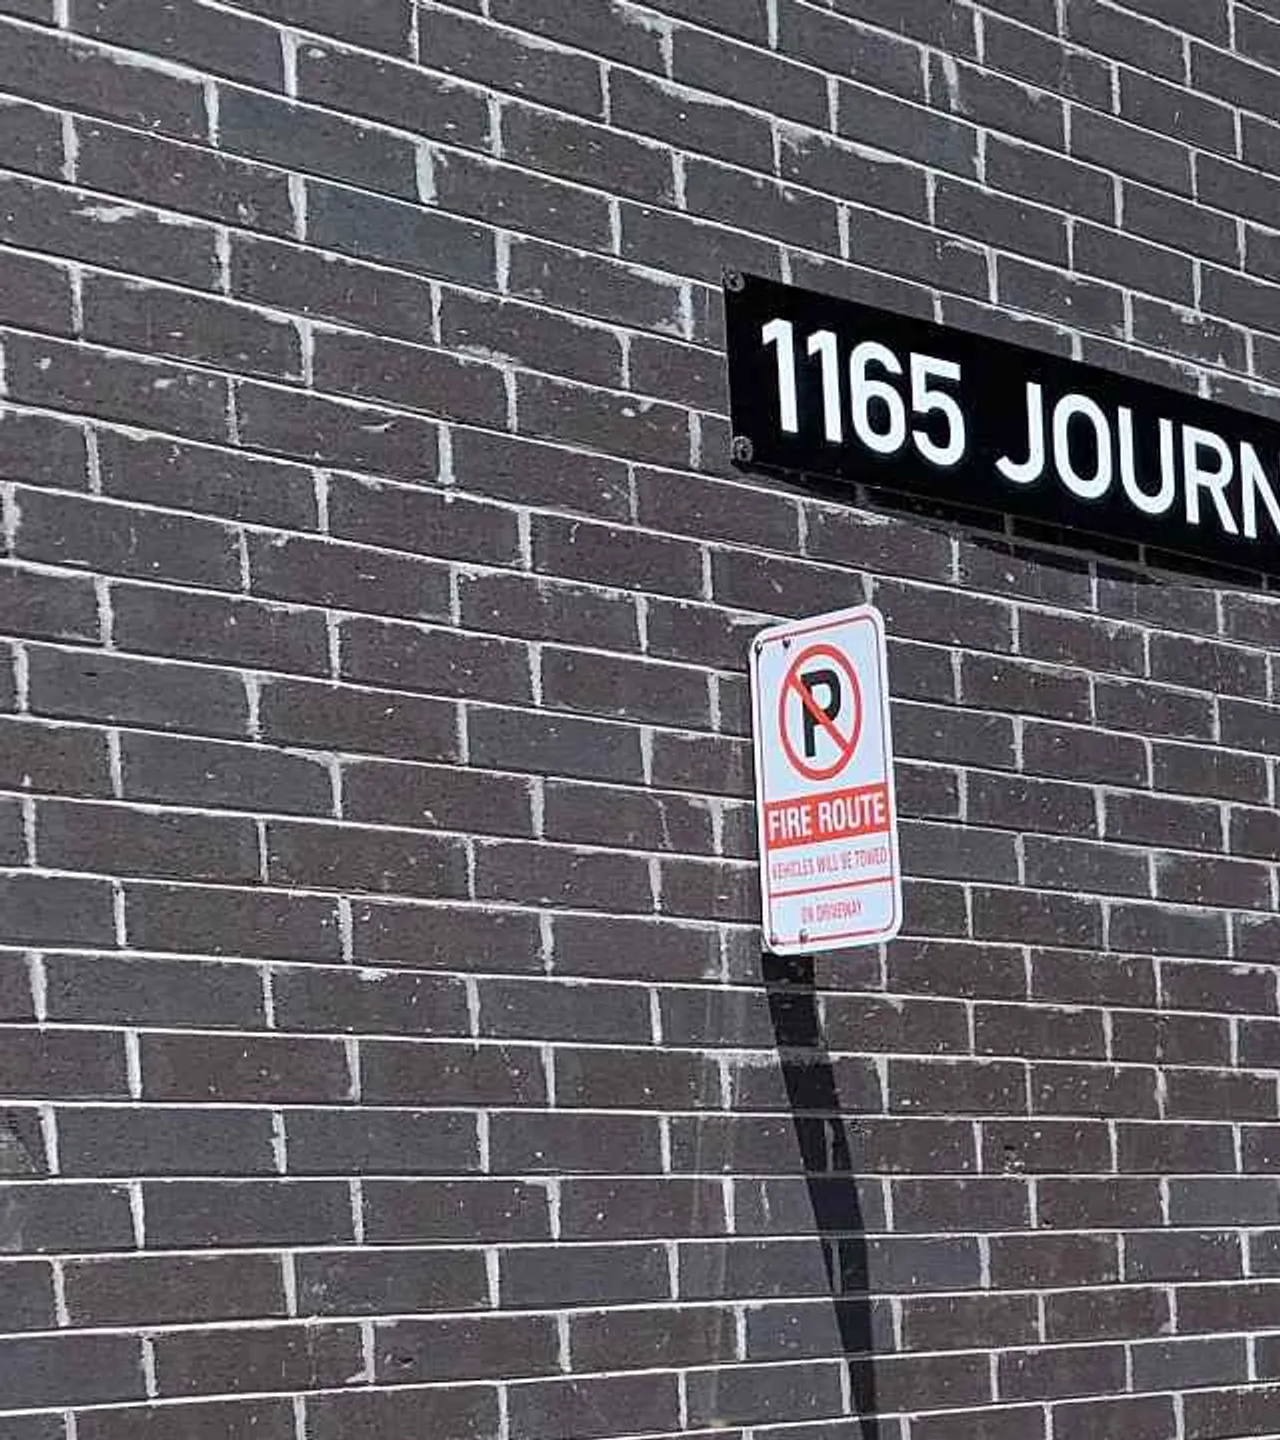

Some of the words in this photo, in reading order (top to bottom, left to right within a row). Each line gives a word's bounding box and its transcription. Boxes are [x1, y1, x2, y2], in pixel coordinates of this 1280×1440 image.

[761, 318, 966, 466] 1165
[800, 669, 841, 757] P
[768, 804, 813, 841] FIRE
[818, 791, 886, 833] ROUTE
[816, 852, 839, 874] WILL
[854, 846, 888, 869] TOWED
